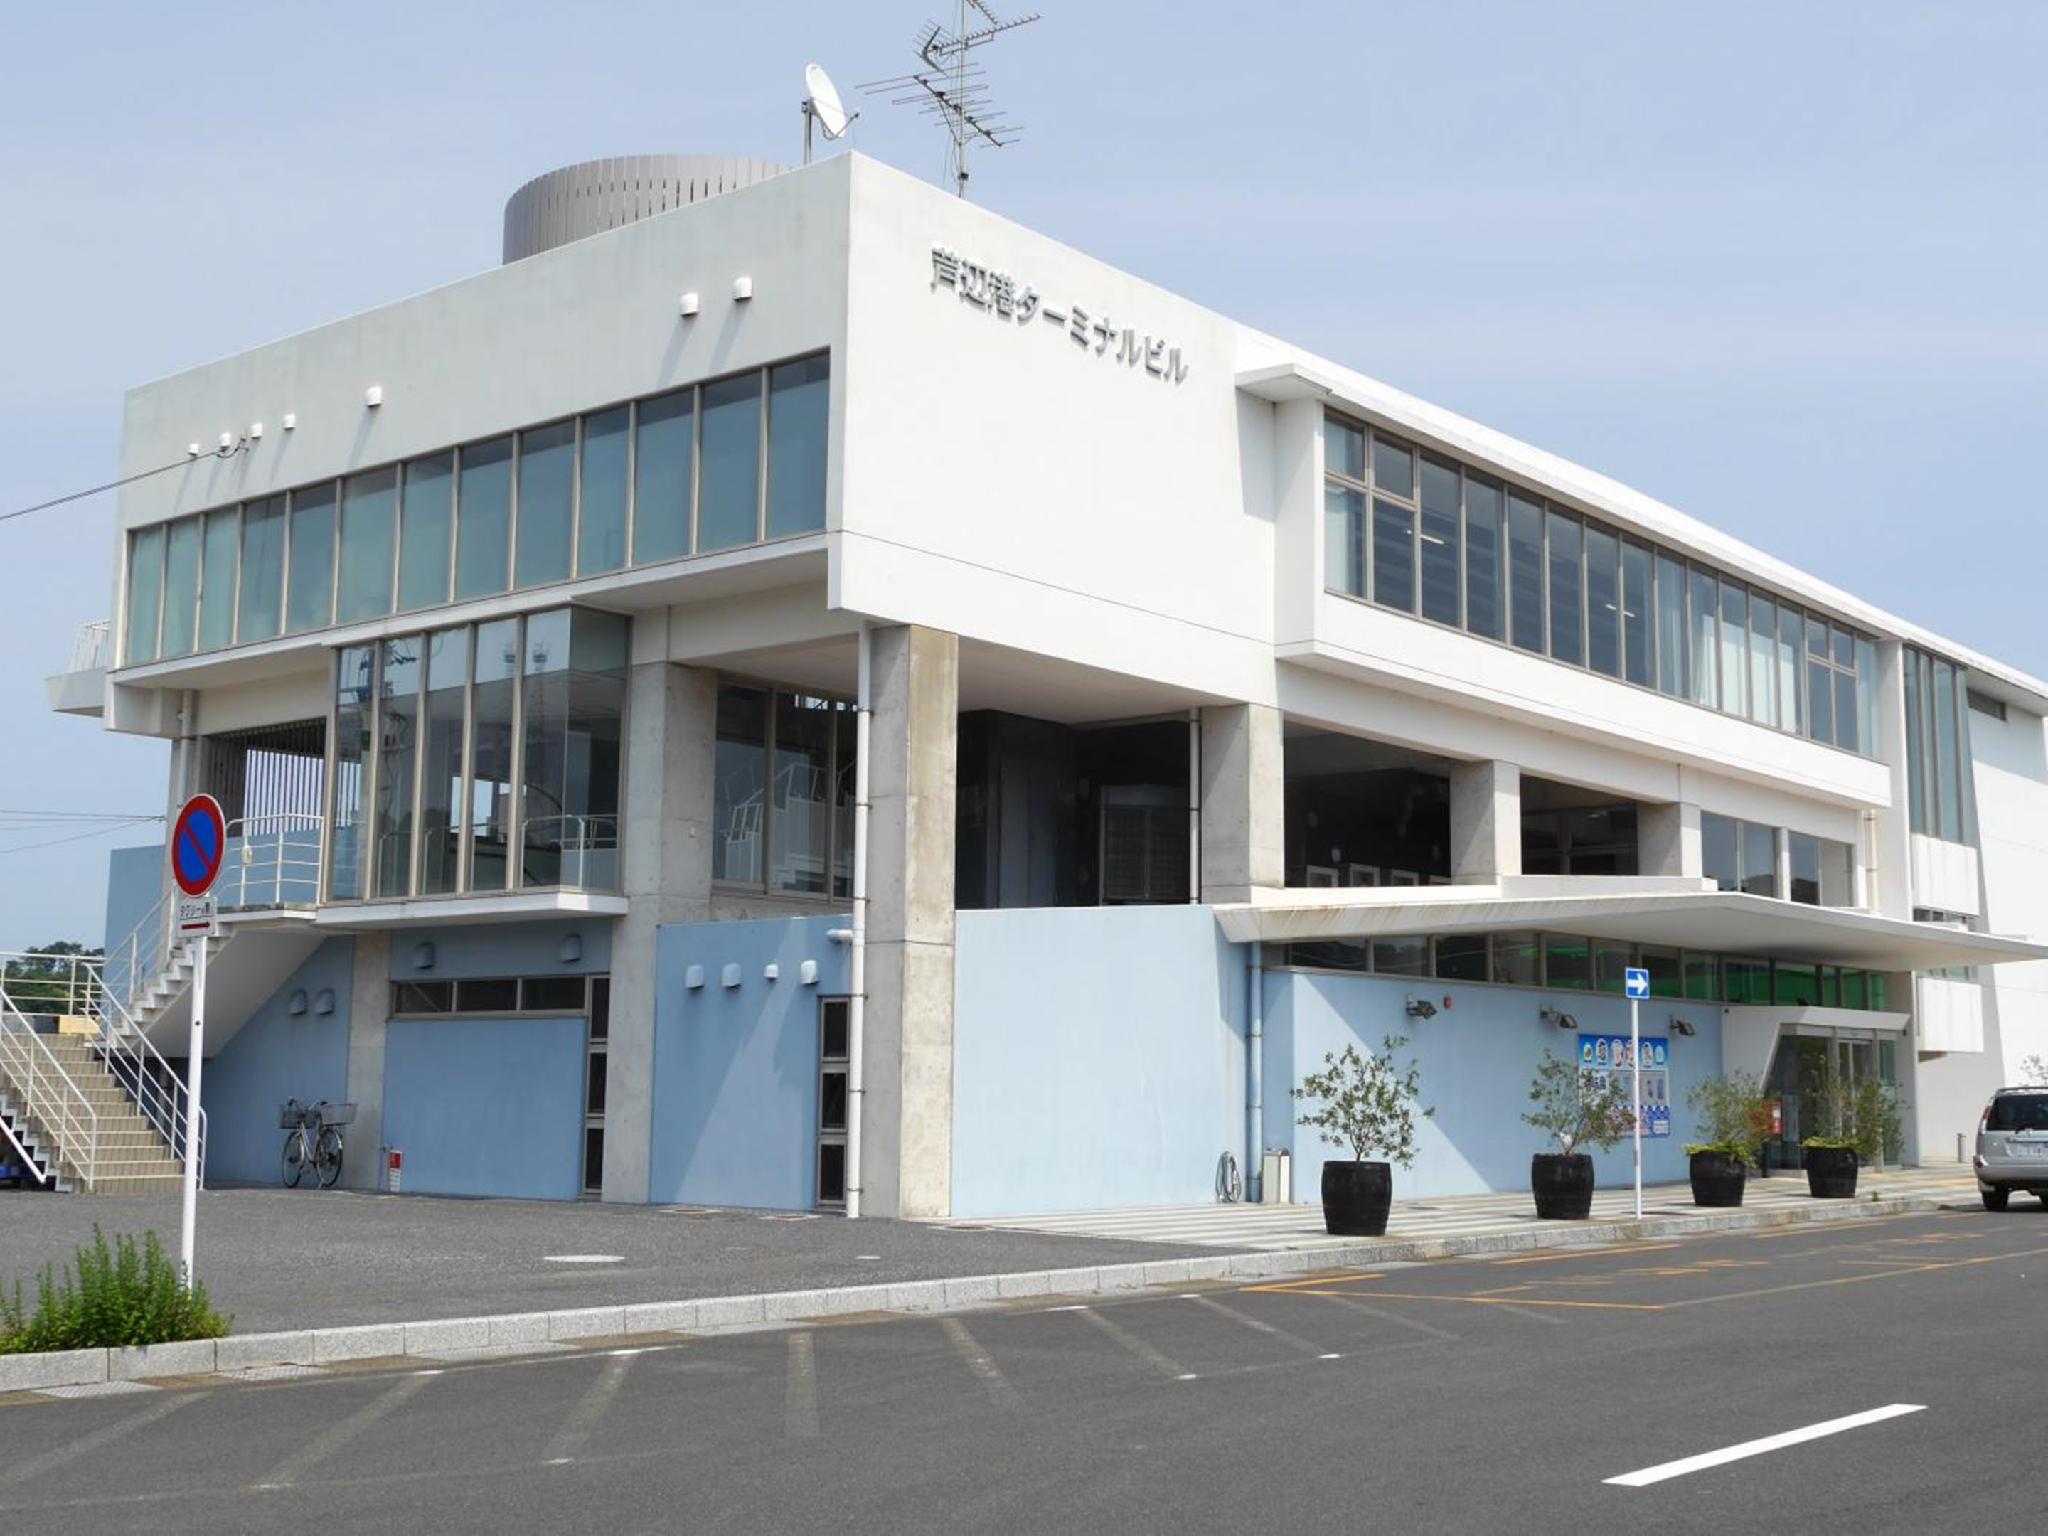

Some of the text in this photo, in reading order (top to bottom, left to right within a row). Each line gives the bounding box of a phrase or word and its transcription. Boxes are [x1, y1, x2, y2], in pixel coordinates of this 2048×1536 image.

[931, 247, 1189, 385] 芦辺港ターミナルビル
